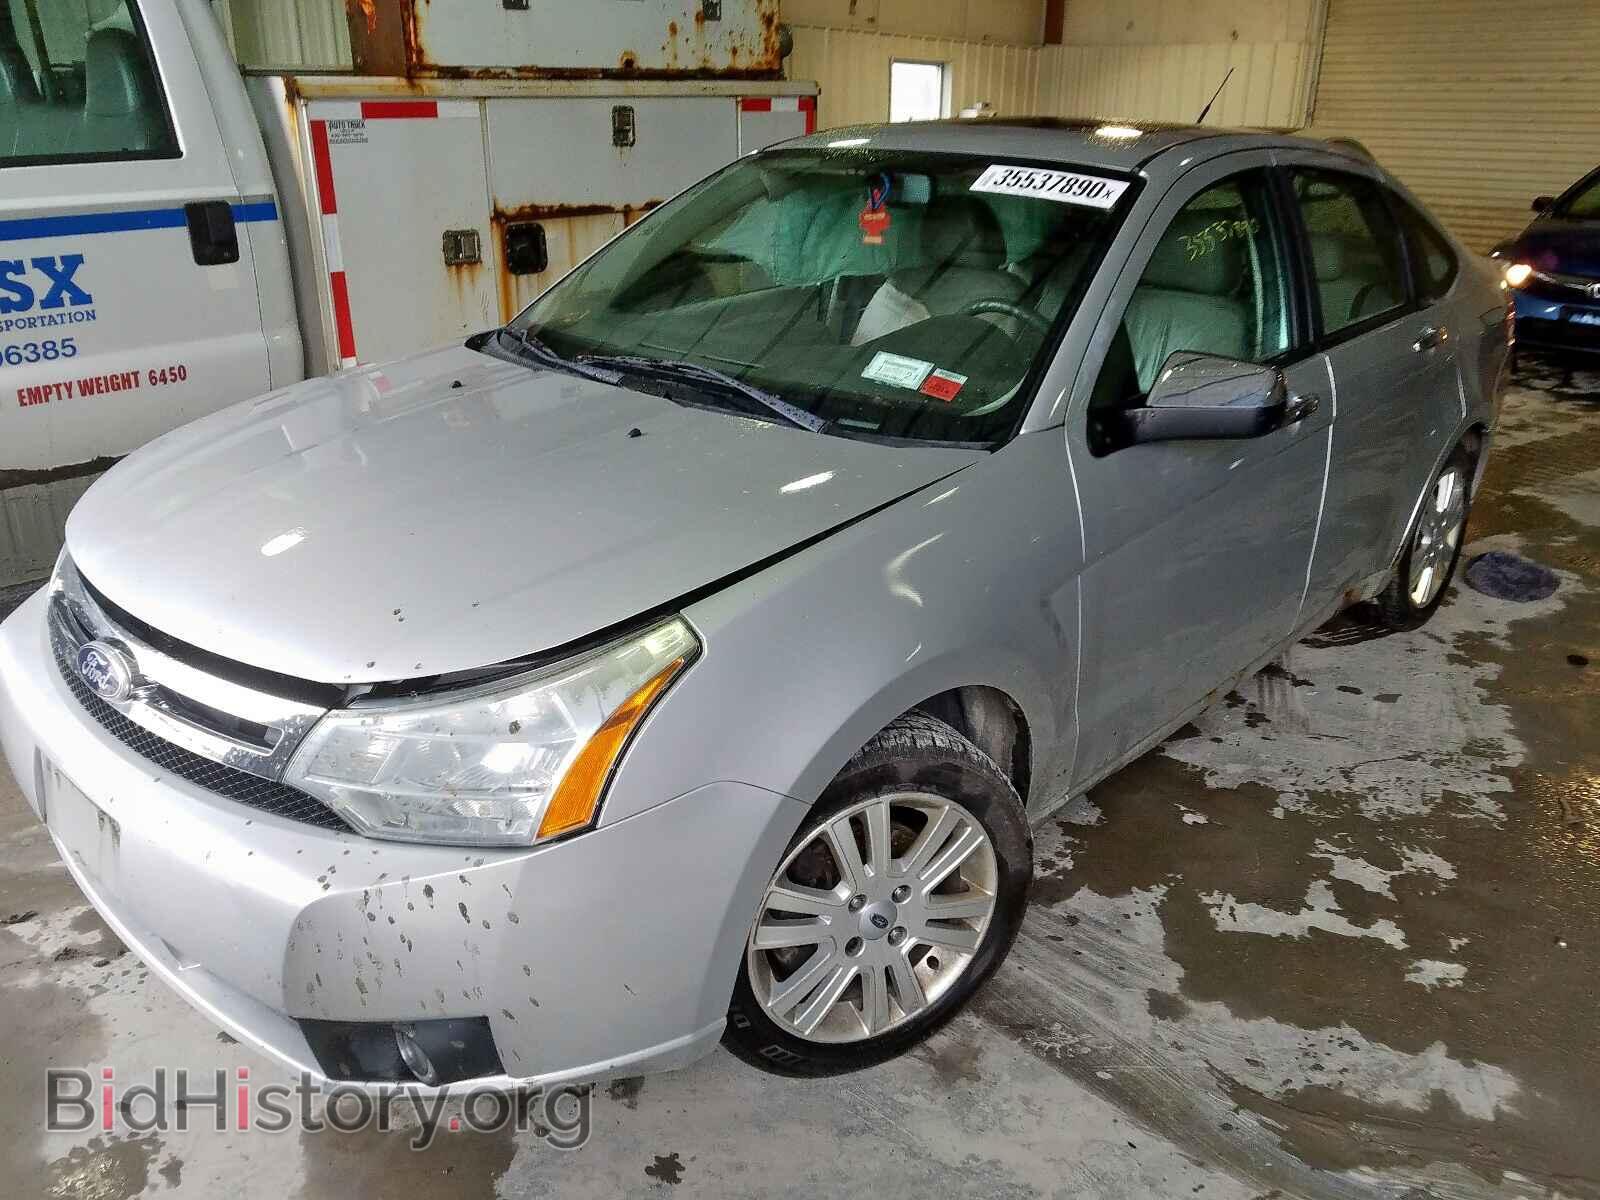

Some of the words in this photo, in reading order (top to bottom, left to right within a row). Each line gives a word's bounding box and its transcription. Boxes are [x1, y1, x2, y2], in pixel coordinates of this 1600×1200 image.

[0, 337, 77, 368] 6385
[17, 381, 73, 407] EMPTY
[77, 371, 140, 397] WEIGHT
[148, 365, 187, 386] 6450
[81, 651, 112, 690] Ford
